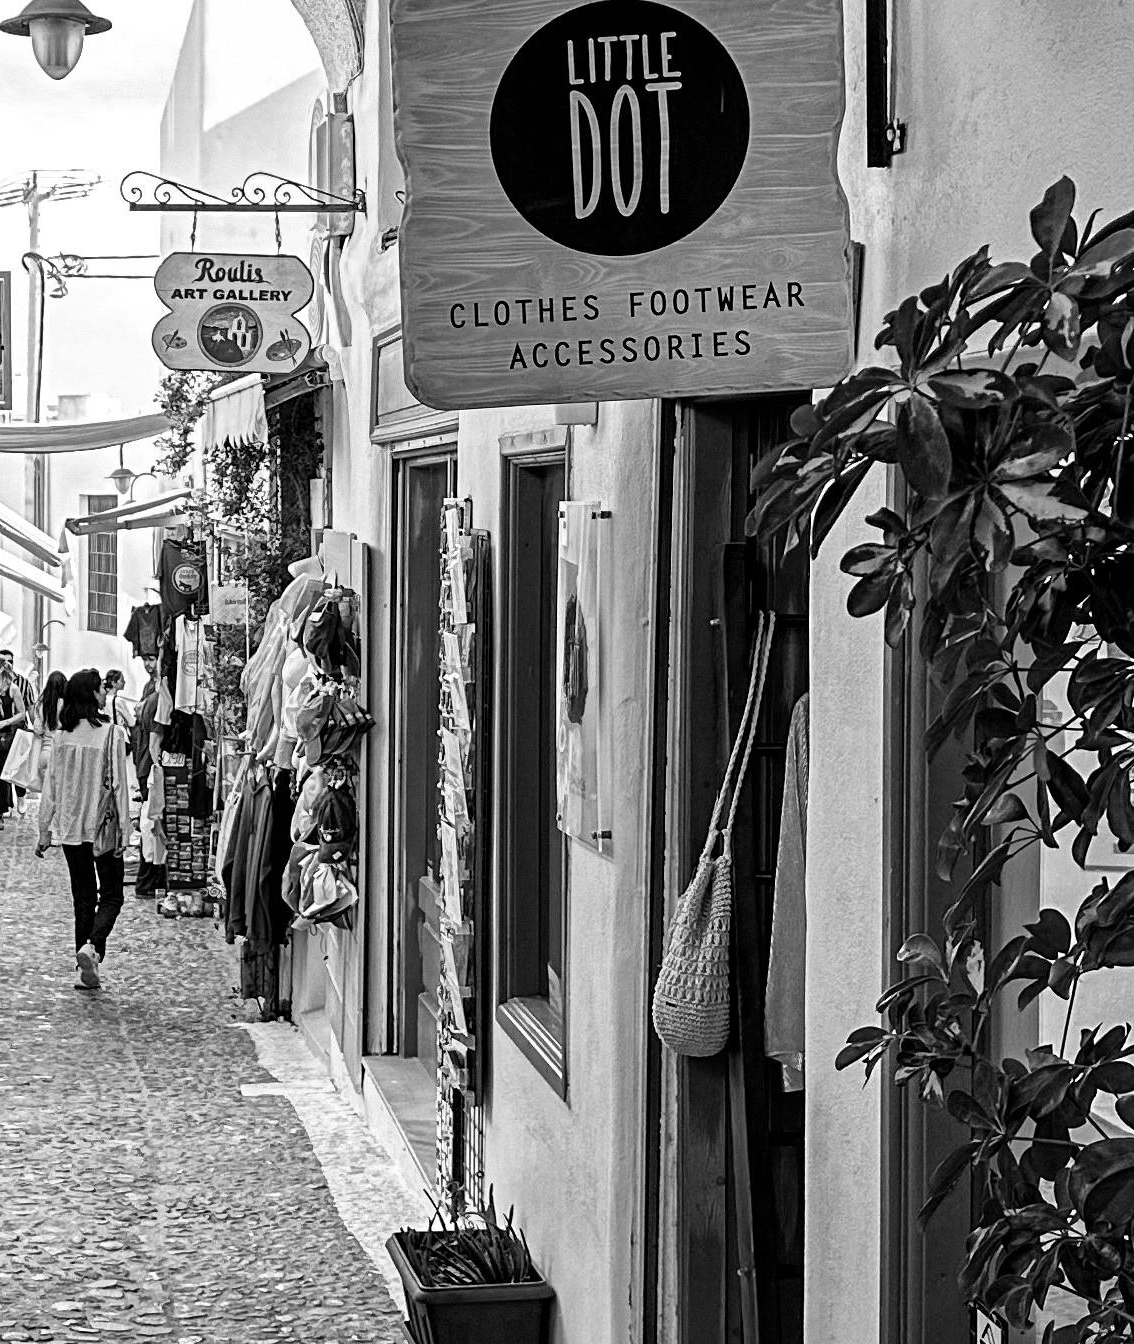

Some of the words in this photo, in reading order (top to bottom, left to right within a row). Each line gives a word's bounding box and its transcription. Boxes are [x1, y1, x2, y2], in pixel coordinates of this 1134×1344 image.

[567, 31, 682, 86] LITTLE
[569, 82, 683, 219] DOT
[192, 257, 272, 284] Roulis
[171, 288, 208, 300] ART
[213, 289, 293, 301] GALLERY
[450, 294, 600, 330] CLOTHES
[629, 281, 806, 319] FOOTWEAR
[509, 330, 751, 371] ACCESSORIES
